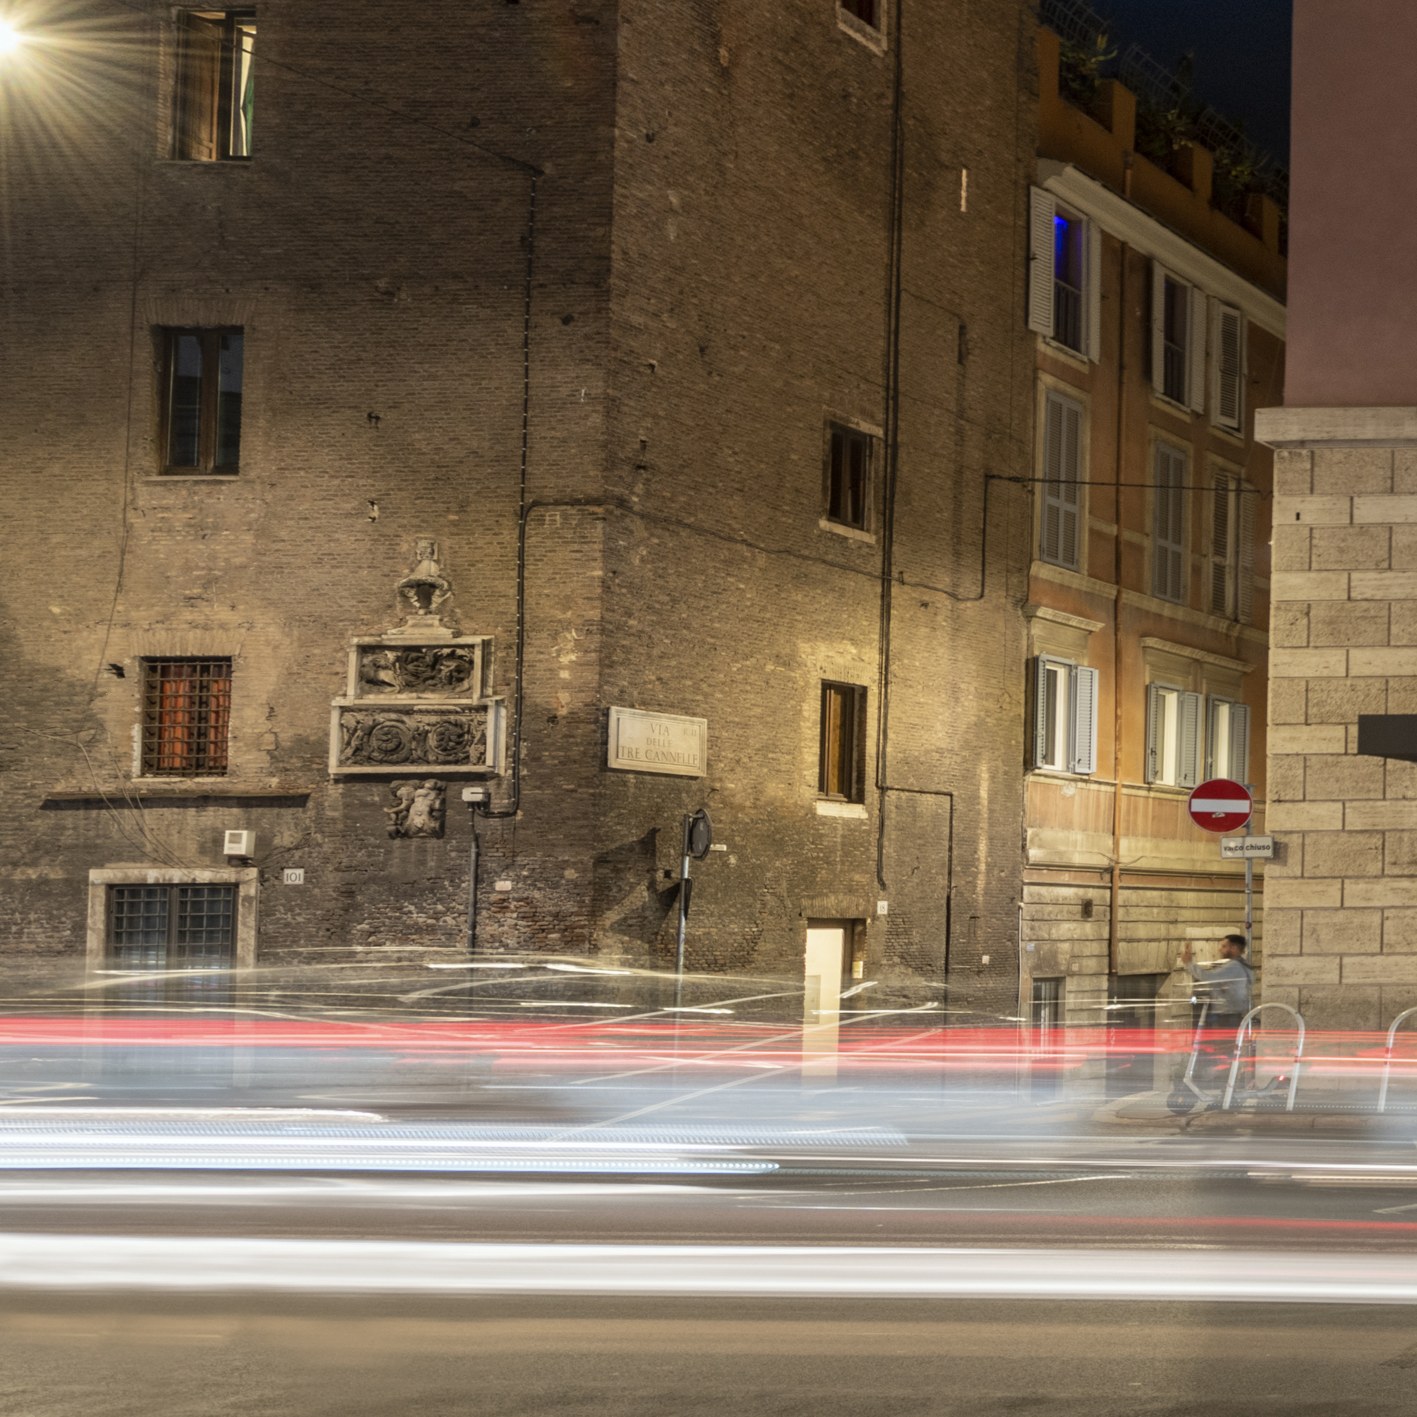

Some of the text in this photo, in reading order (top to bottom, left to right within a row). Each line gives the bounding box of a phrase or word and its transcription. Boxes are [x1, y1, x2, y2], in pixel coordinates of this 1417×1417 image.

[650, 723, 670, 736] VIA
[646, 737, 672, 748] DELLE
[620, 745, 698, 765] TRE CANNELLE
[1245, 843, 1271, 851] chiuso
[286, 872, 301, 882] 101
